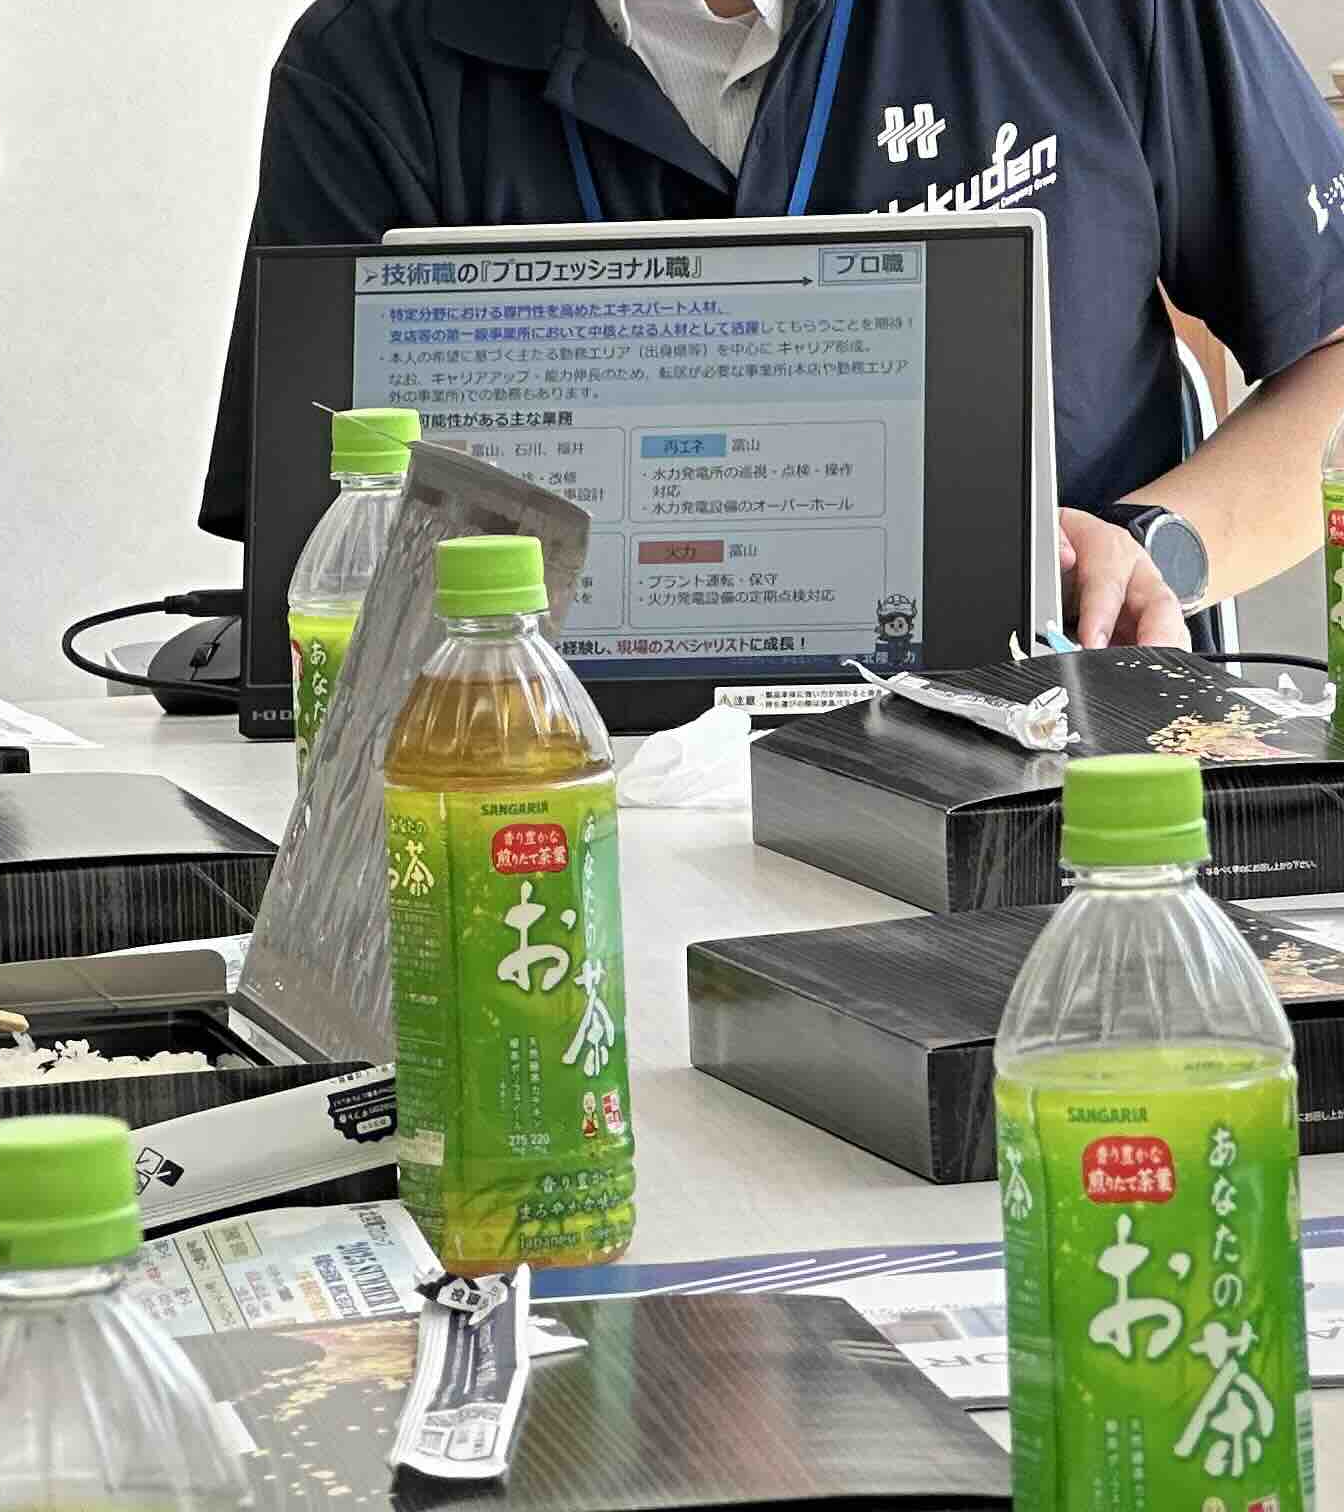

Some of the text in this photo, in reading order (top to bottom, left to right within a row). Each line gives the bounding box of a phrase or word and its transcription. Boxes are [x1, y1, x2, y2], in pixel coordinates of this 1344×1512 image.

[869, 122, 1057, 211] kuden
[382, 255, 703, 286] 技術職の『プロフェッショナル職』
[836, 252, 905, 276] プロ職
[480, 800, 549, 816] SANGARIA
[1208, 1127, 1243, 1307] あなたの
